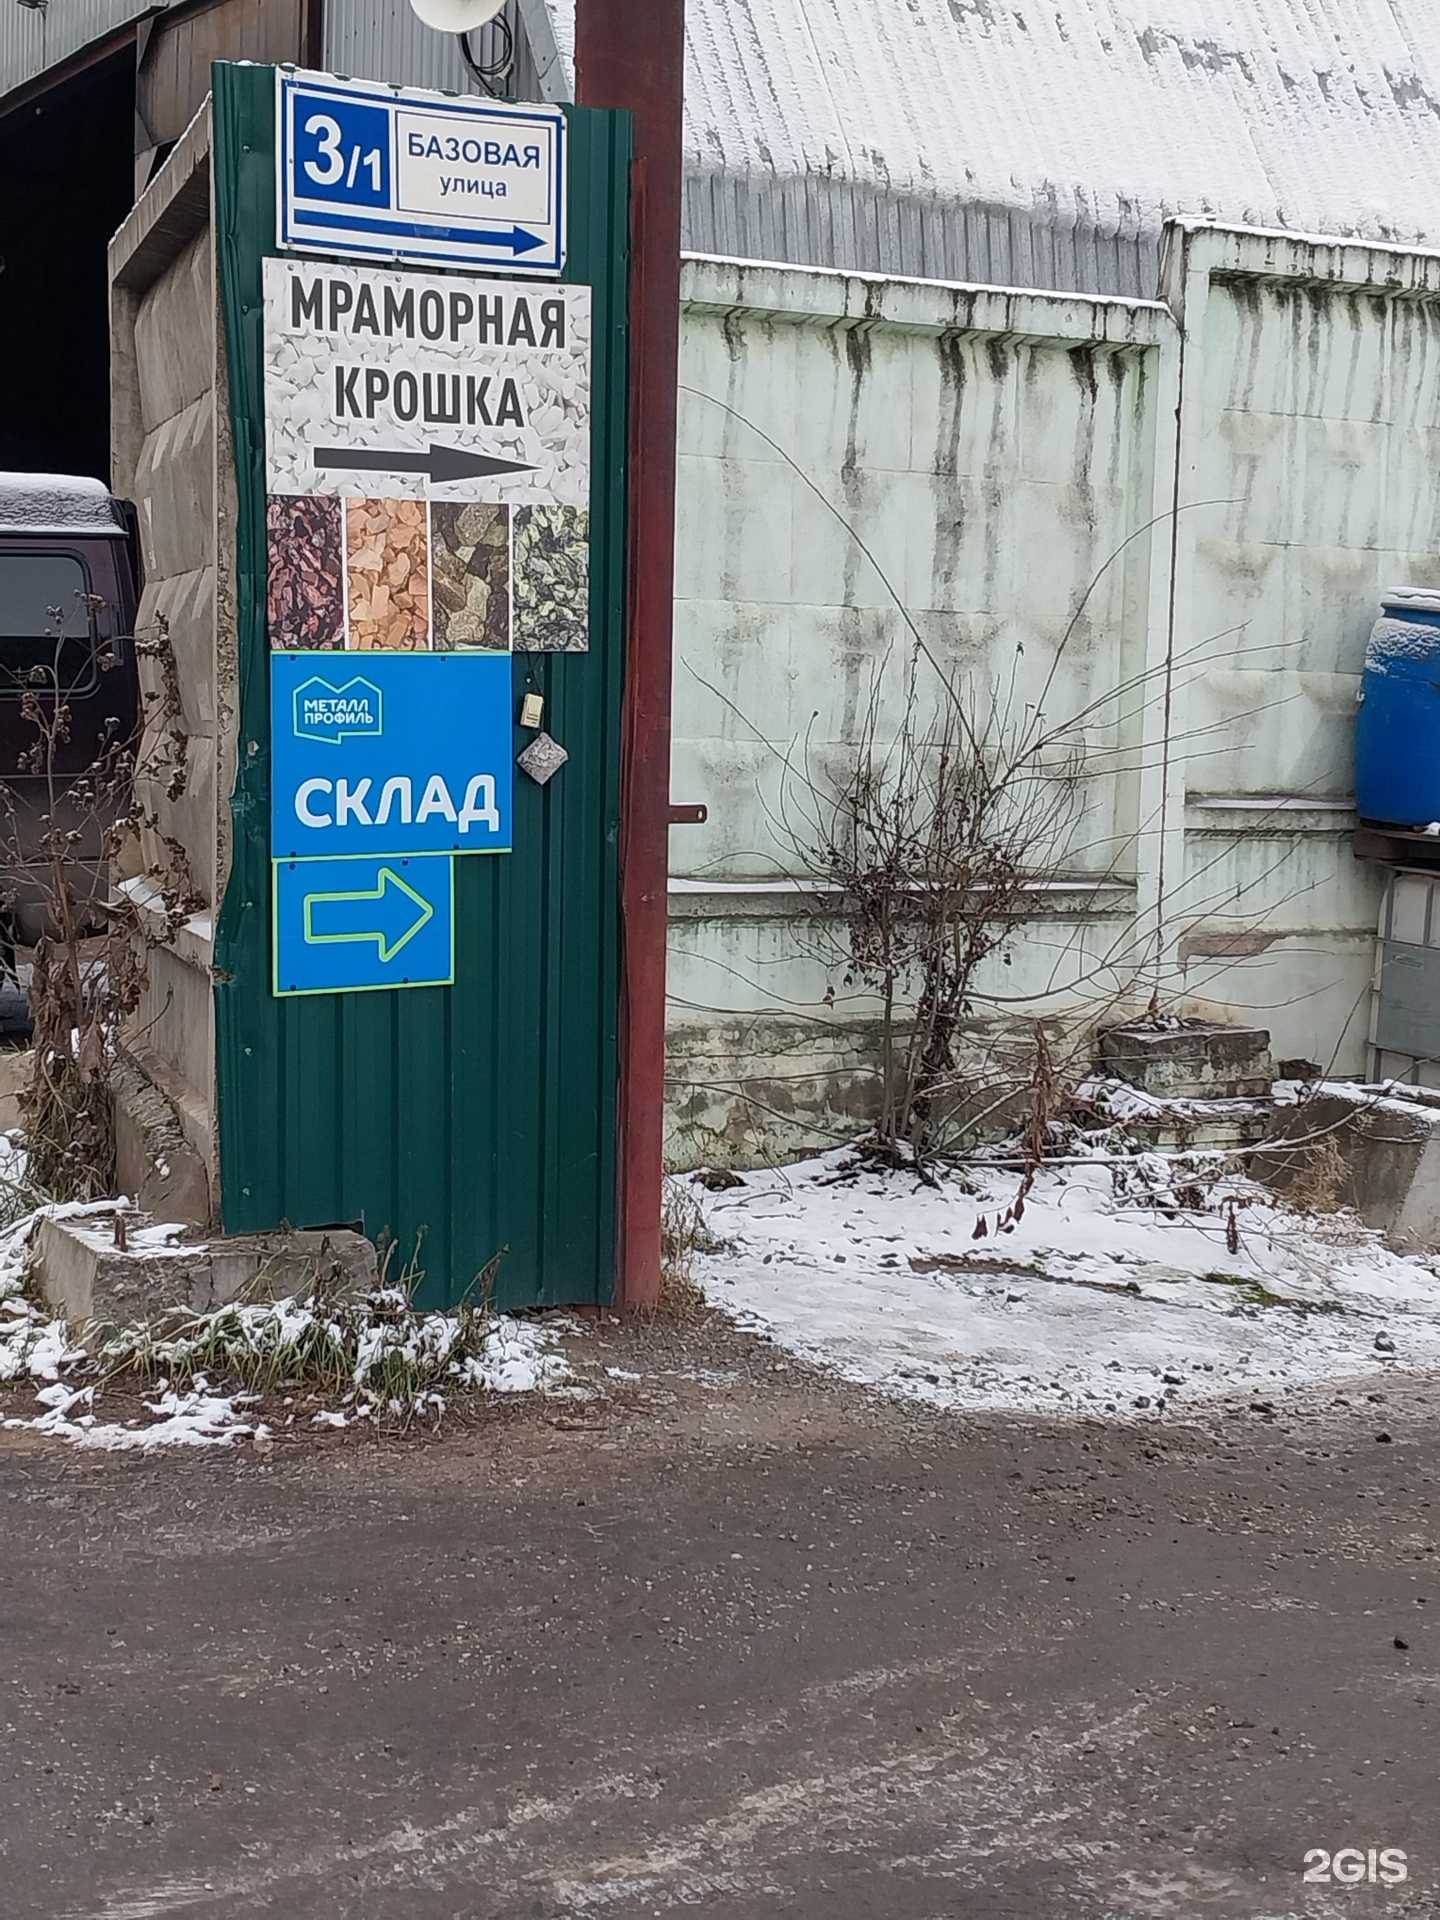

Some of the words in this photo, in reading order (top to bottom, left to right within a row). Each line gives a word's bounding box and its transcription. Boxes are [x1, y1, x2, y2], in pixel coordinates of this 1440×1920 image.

[303, 114, 382, 191] 3/1
[408, 133, 541, 169] БАЗОВАЯ
[440, 176, 507, 198] улица
[291, 275, 565, 348] МРАМОРНАЯ
[335, 365, 525, 427] КРОШКА
[304, 699, 369, 713] МЕТАЛЛ
[304, 712, 374, 725] ПРОФИЛЬ
[294, 774, 500, 833] СКЛАД
